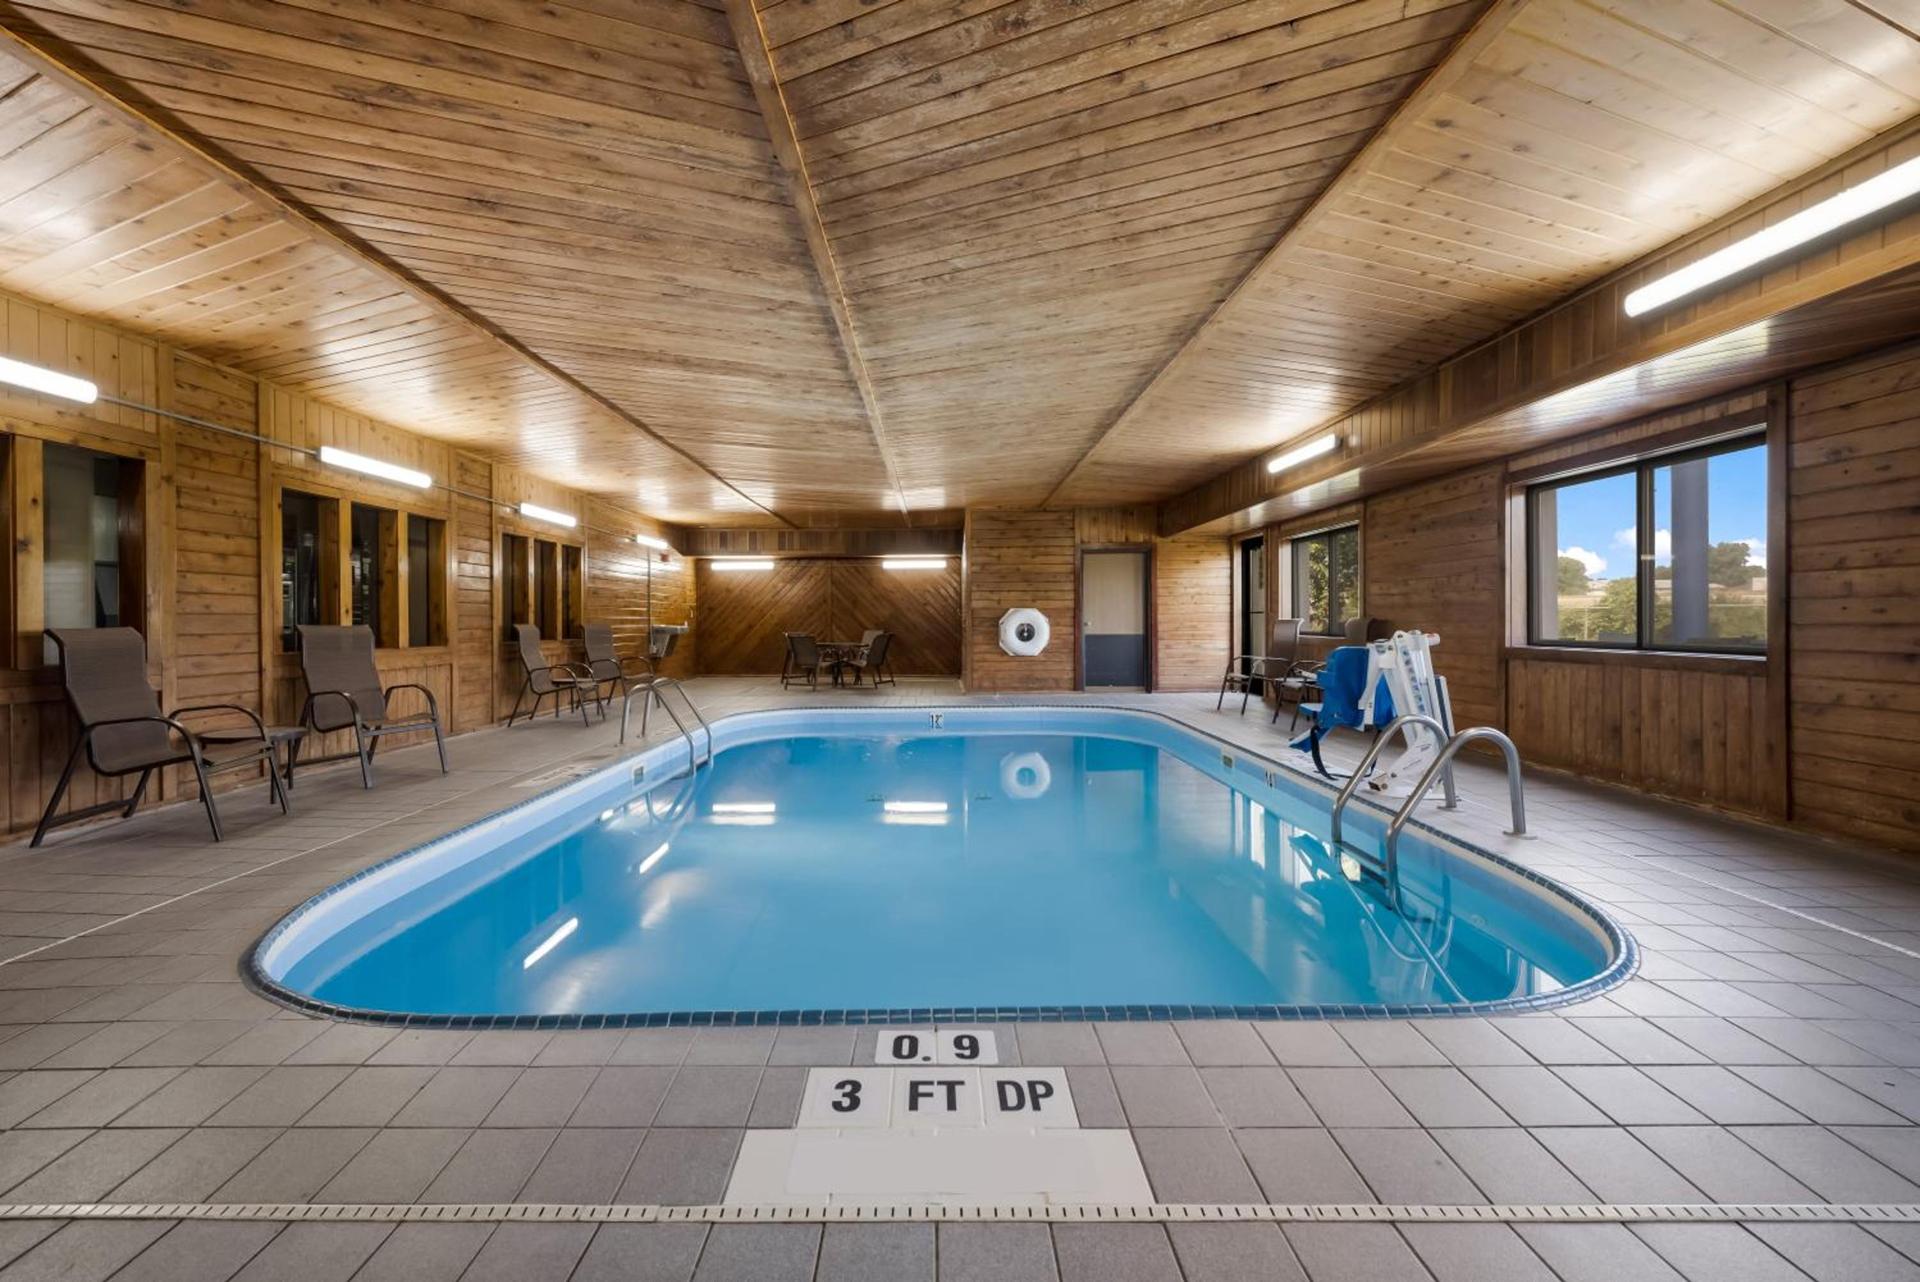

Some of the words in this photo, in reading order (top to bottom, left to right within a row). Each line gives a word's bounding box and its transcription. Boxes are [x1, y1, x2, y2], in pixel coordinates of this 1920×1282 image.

[831, 1079, 862, 1113] 3
[908, 1080, 966, 1112] FT
[996, 1080, 1054, 1112] DP
